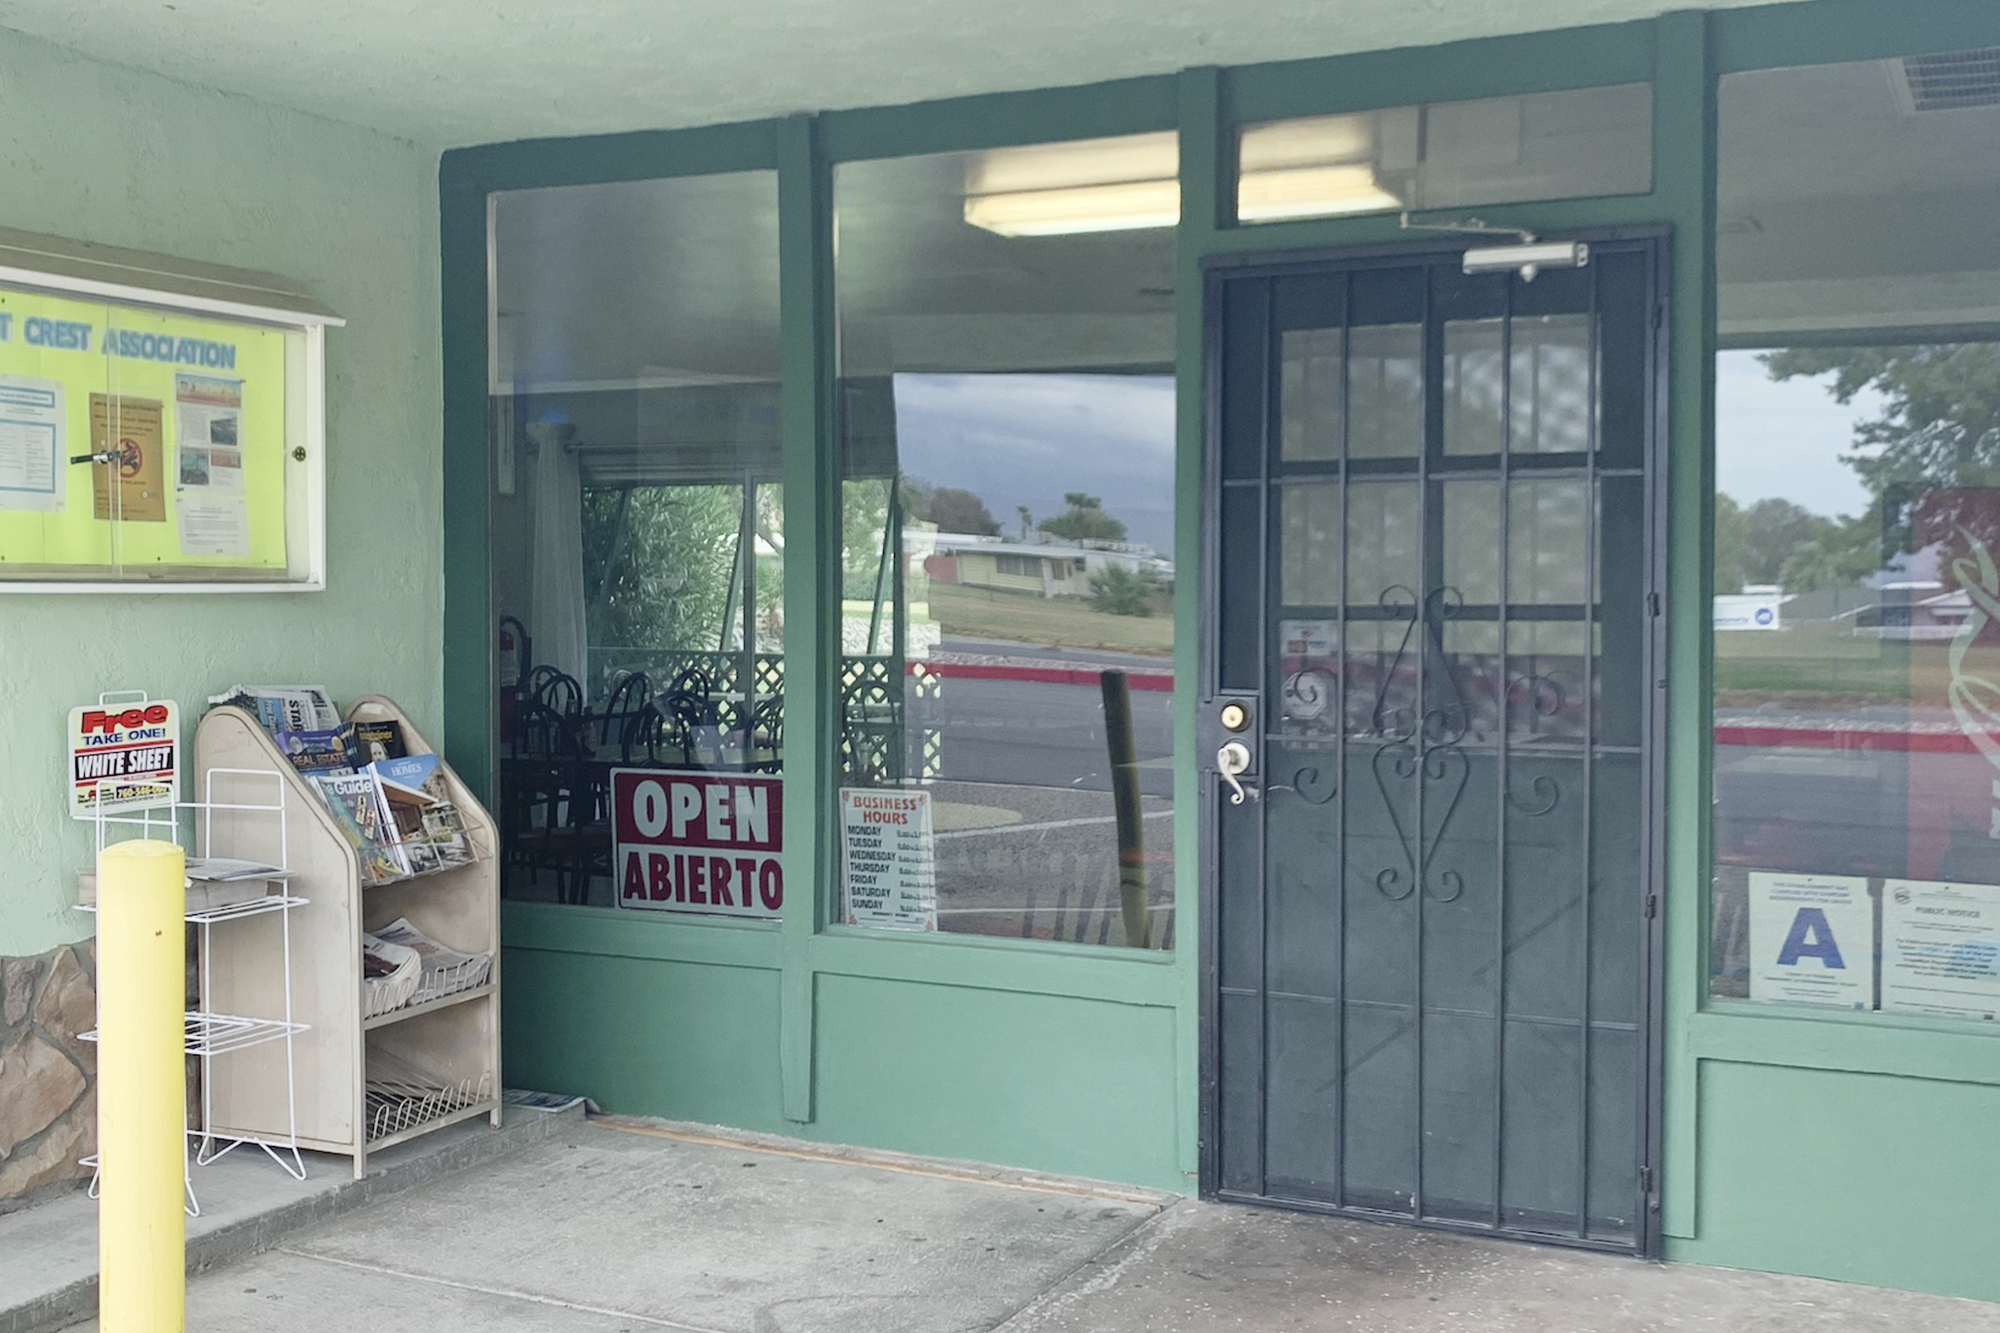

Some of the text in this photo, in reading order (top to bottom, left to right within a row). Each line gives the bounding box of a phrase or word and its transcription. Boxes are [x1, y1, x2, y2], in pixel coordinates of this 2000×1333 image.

[24, 316, 92, 350] CREST
[101, 328, 236, 370] ASSOCIATION
[81, 705, 168, 734] Free
[82, 728, 166, 745] TAKE ONE!
[78, 747, 171, 779] WHITE SHEET
[292, 752, 348, 766] REAL ESTATE
[391, 763, 422, 777] HOMES
[334, 778, 374, 796] Guide
[854, 796, 917, 810] BUSINESS
[633, 780, 769, 843] OPEN
[863, 811, 908, 825] HOURS
[848, 825, 882, 836] MONDAY
[849, 837, 883, 848] TUESDAY
[850, 850, 896, 861] WEDNESDAY
[850, 862, 890, 873] THURSDAY
[623, 852, 783, 911] ABIERTO
[850, 874, 877, 885] FRIDAY
[851, 886, 891, 898] SATURDAY
[852, 898, 883, 910] SUNDAY
[1776, 907, 1846, 969] A
